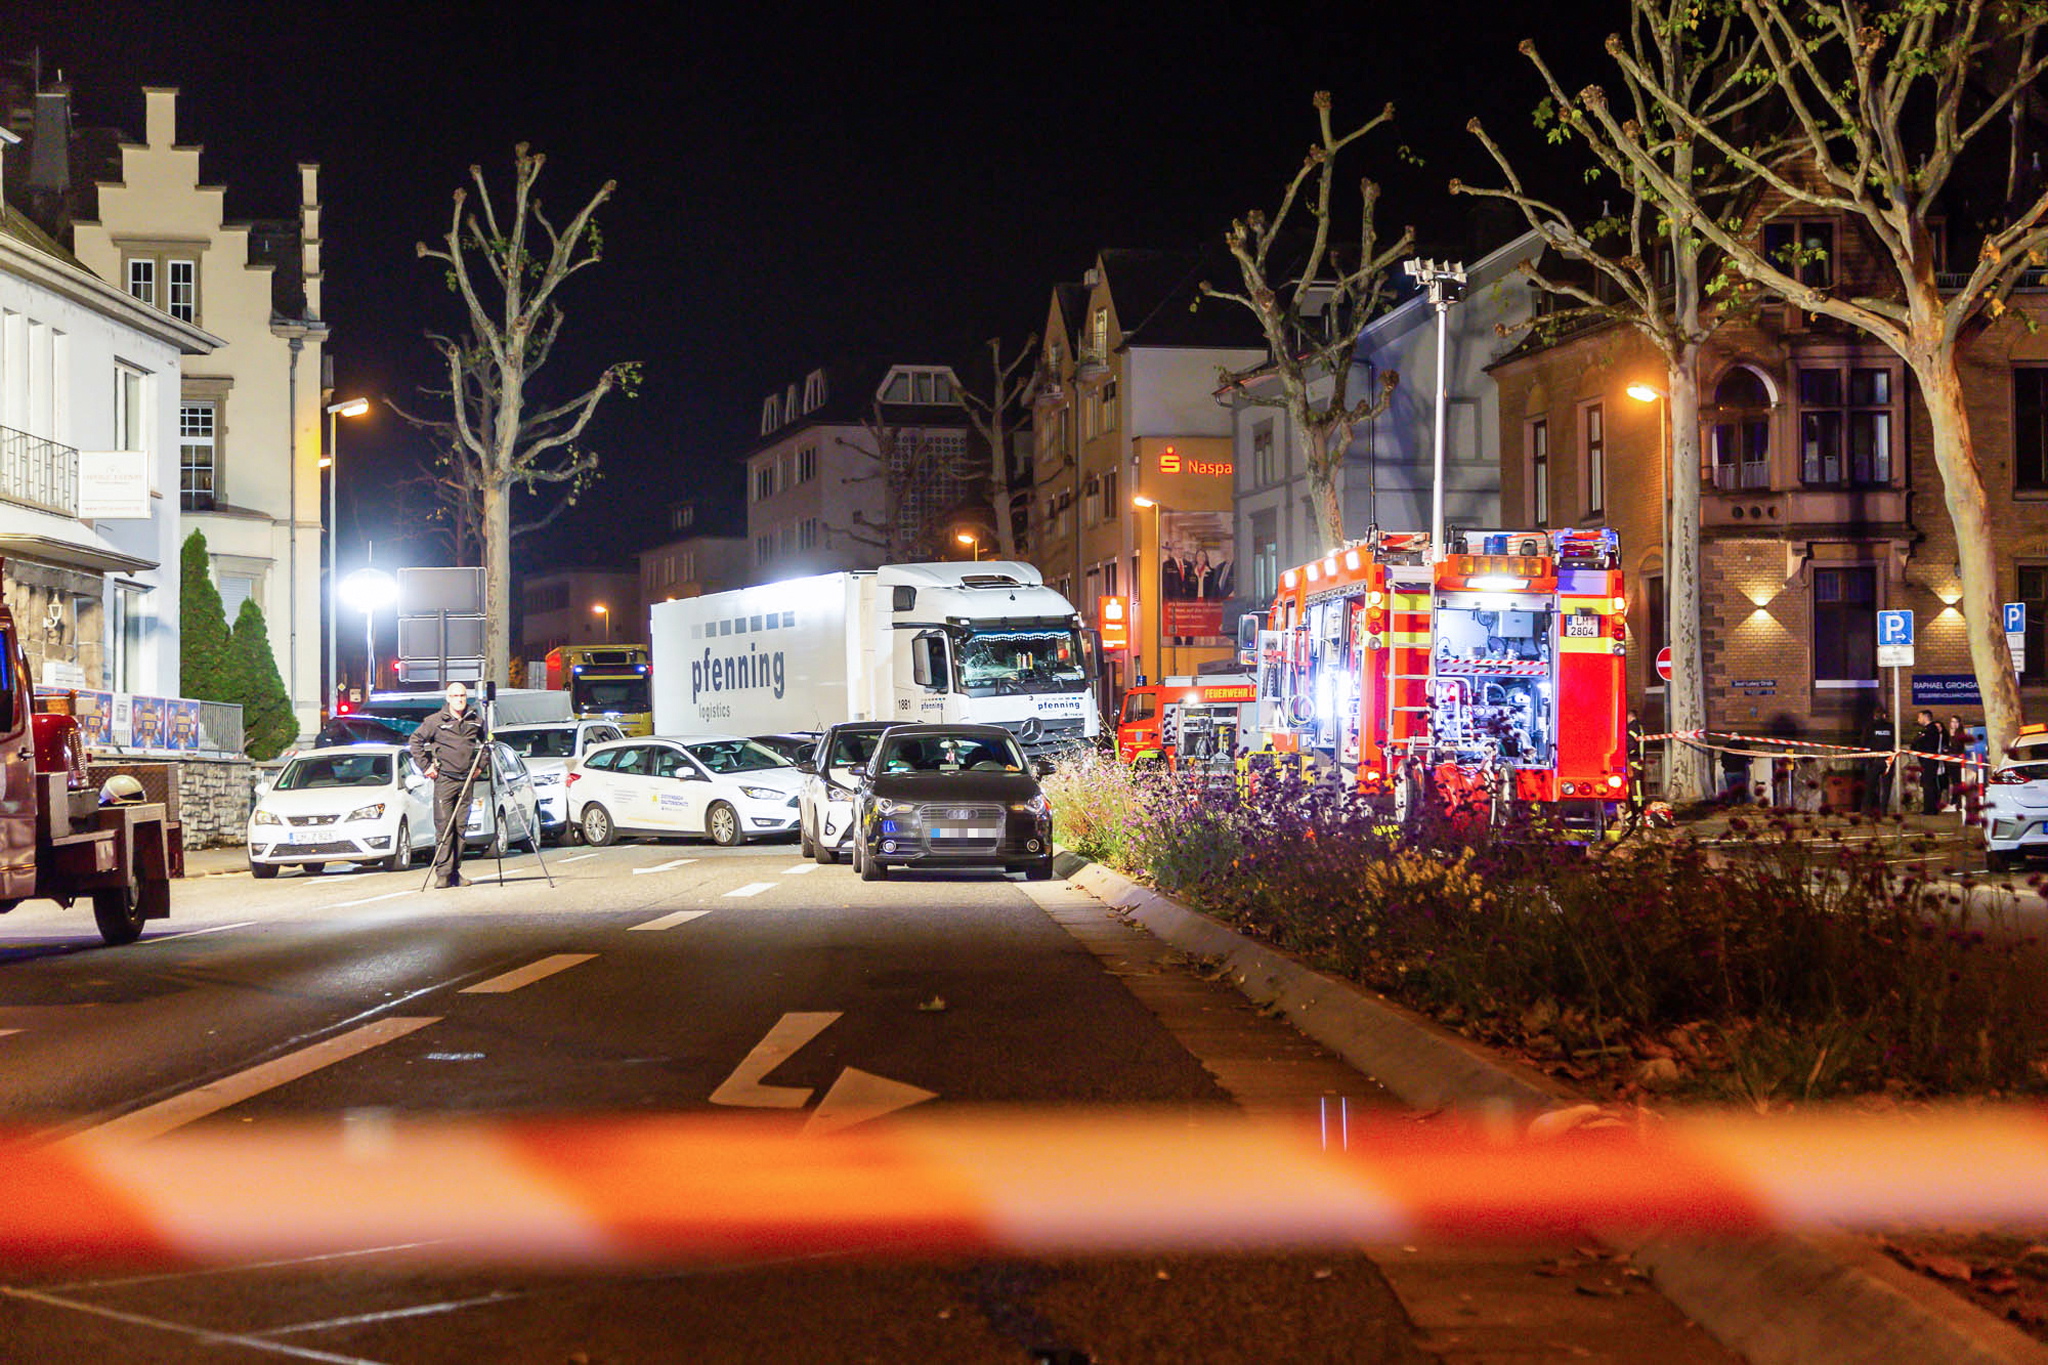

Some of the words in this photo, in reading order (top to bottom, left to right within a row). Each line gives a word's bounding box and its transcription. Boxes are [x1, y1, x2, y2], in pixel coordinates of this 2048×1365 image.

[1188, 459, 1233, 478] Naspa
[2008, 607, 2021, 630] P
[1571, 627, 1594, 636] 2804
[1885, 615, 1905, 641] P
[691, 642, 785, 704] pfenning
[1913, 681, 1944, 689] RAPHAEL
[1204, 687, 1248, 698] FEUERWEHR
[898, 699, 911, 710] 1881
[921, 702, 943, 711] pfenning
[1037, 701, 1080, 710] pfenning
[699, 702, 731, 722] logistics
